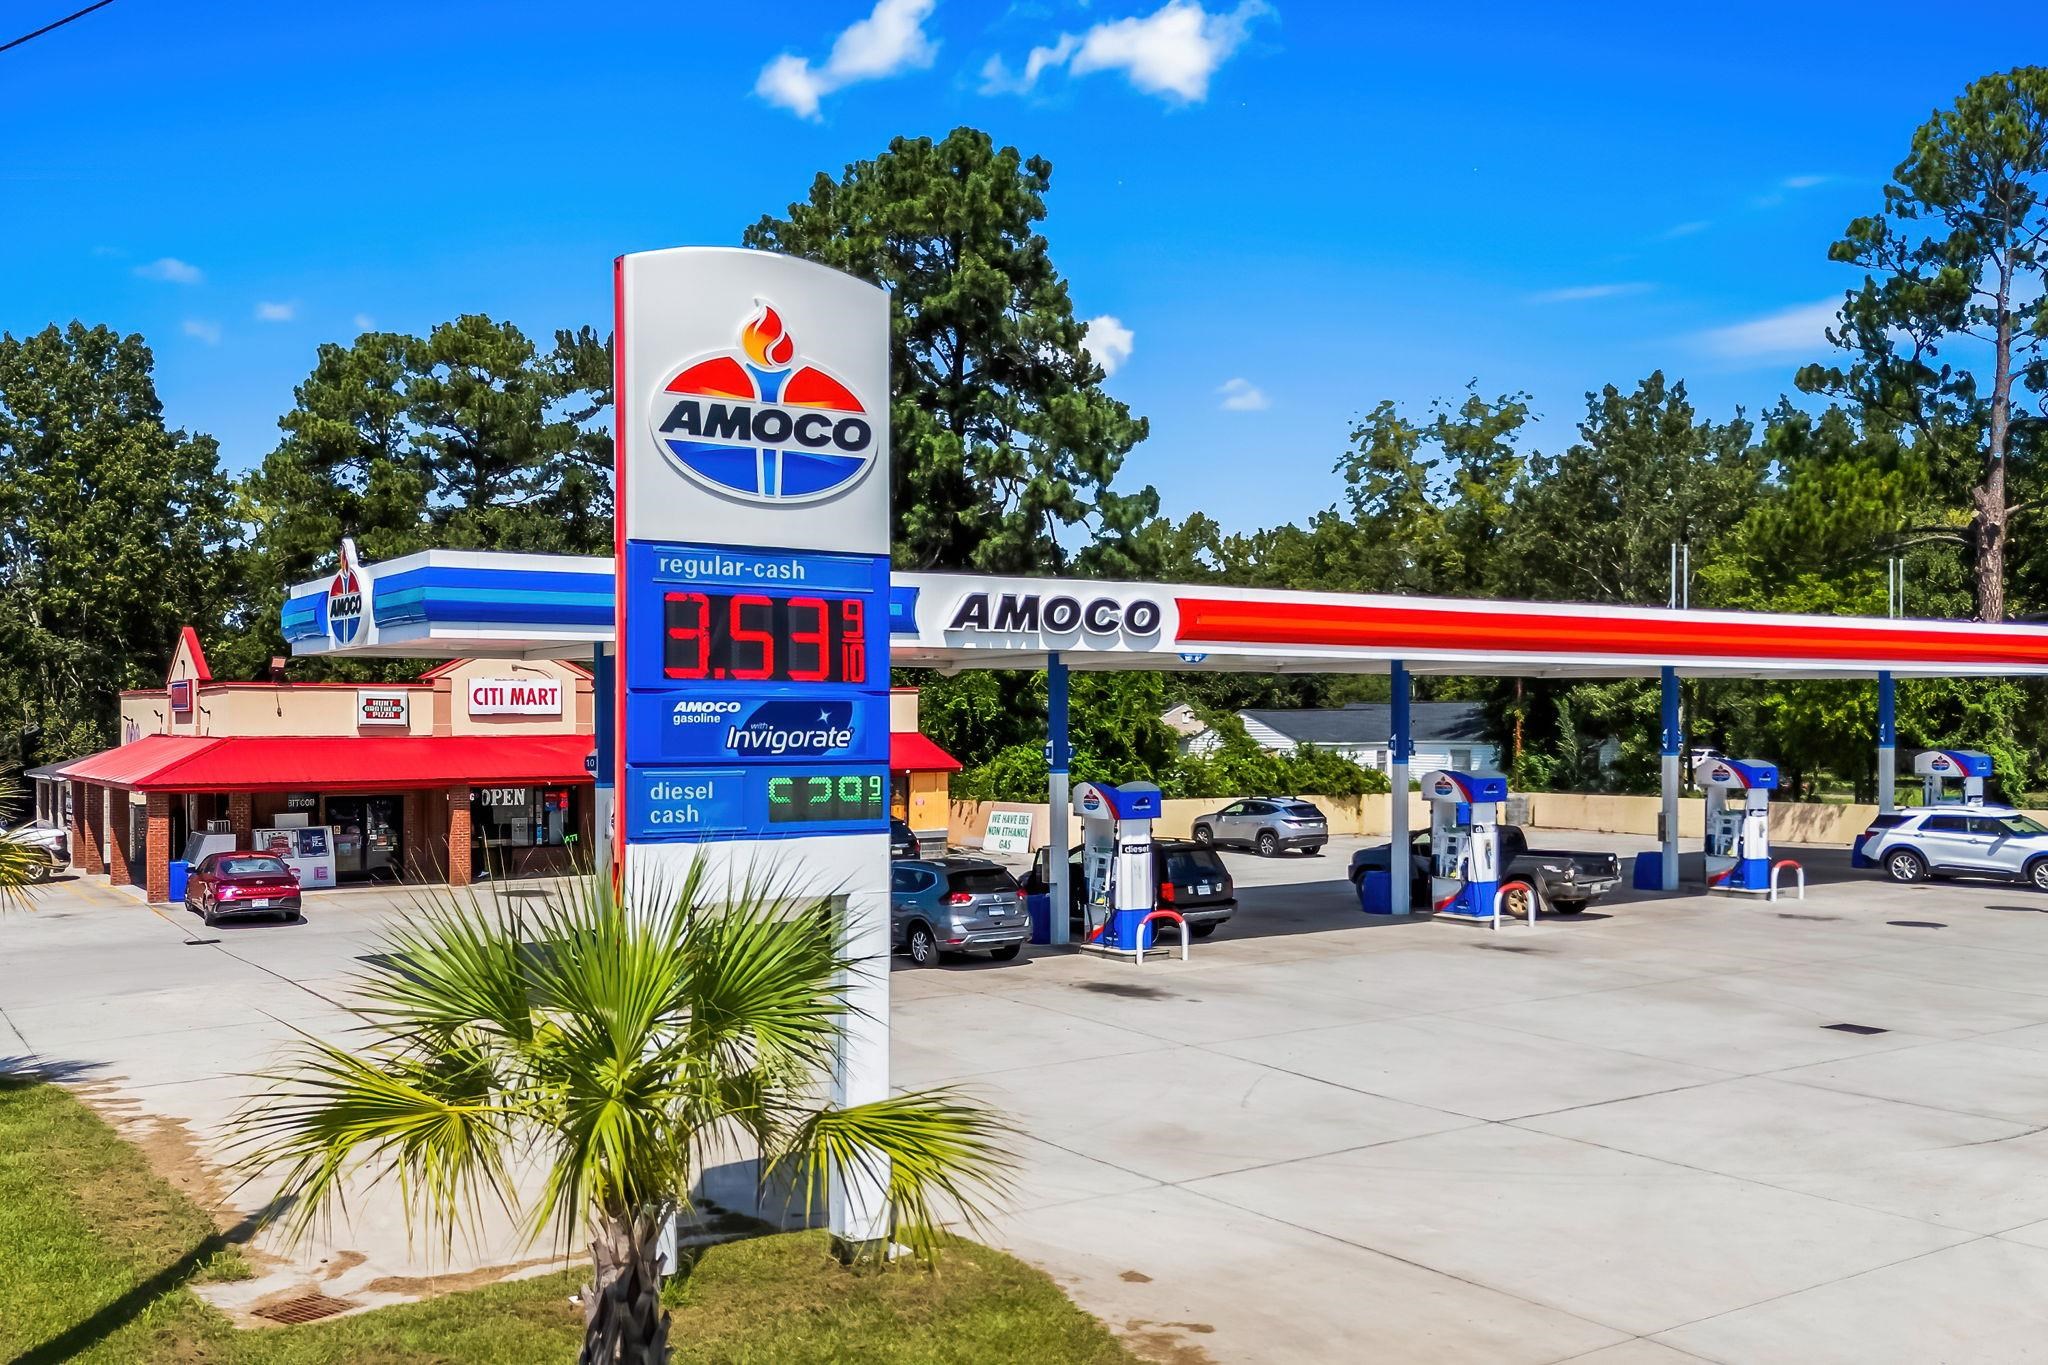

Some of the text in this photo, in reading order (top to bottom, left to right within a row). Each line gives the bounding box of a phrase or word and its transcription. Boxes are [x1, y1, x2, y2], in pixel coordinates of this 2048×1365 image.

[659, 400, 871, 451] AMOCO
[659, 556, 805, 579] regular-cash
[330, 595, 361, 617] AMOCO
[948, 592, 1161, 634] AMOCO
[664, 592, 829, 681] 3.53
[473, 688, 557, 705] CITI MART
[673, 701, 741, 713] AMOCO
[673, 713, 721, 726] gasoline
[751, 722, 769, 730] with
[726, 726, 851, 754] Invigorate
[586, 758, 595, 768] 10
[481, 788, 526, 806] OPEN
[650, 782, 713, 800] diesel
[650, 805, 699, 824] cash
[992, 814, 1001, 823] WE
[1002, 815, 1018, 824] HAVE
[988, 826, 1028, 838] NON ETHANOL
[999, 839, 1012, 849] GAS
[1124, 845, 1149, 853] diesel
